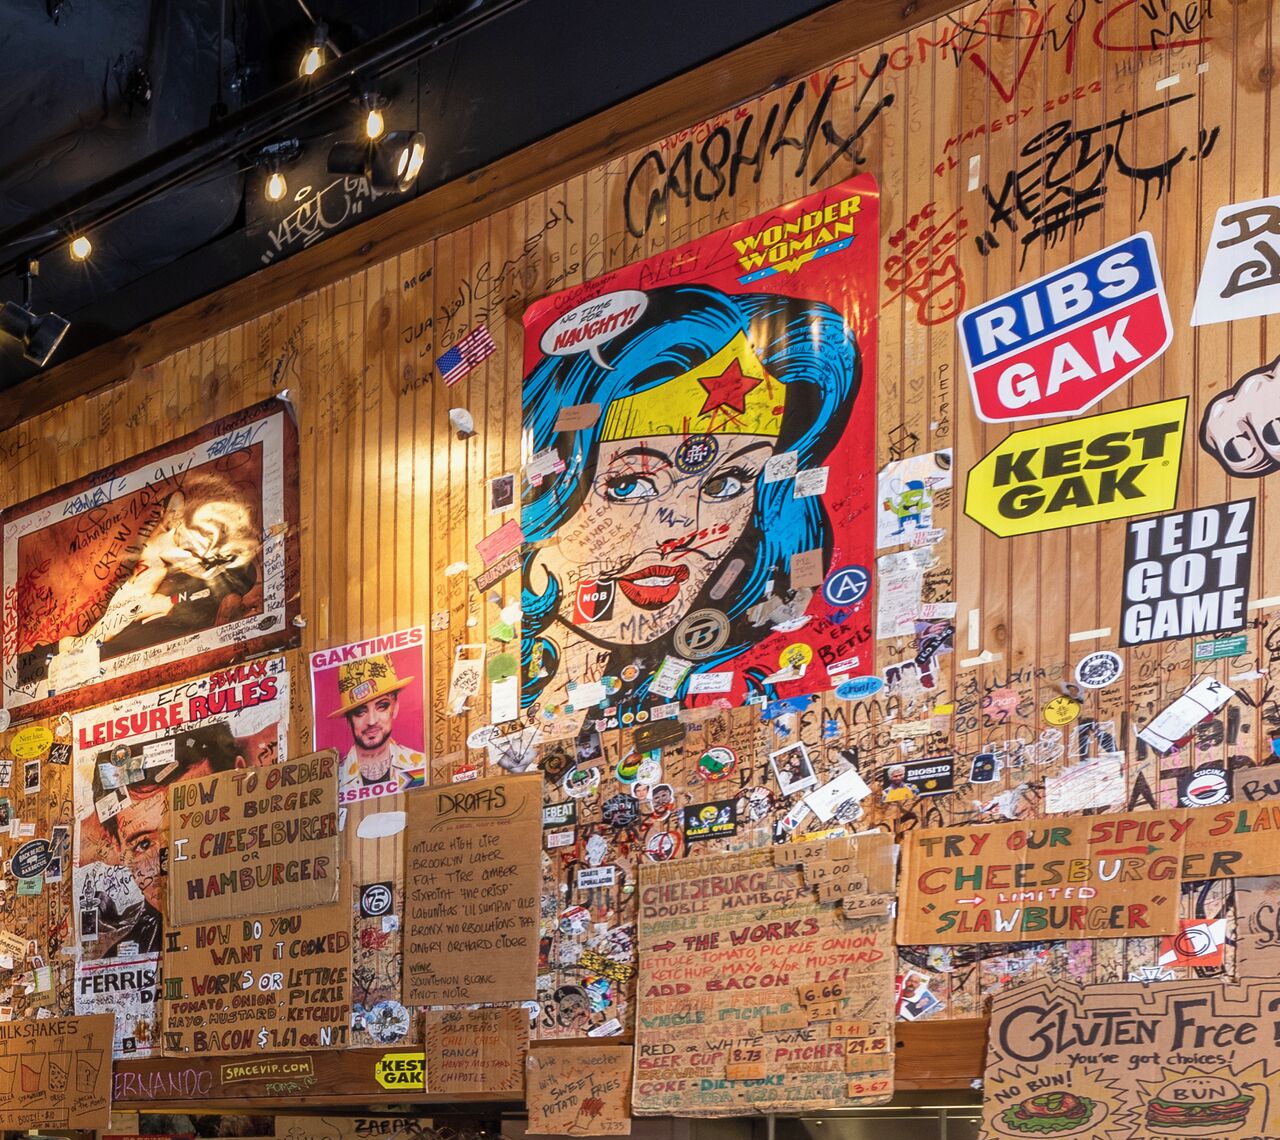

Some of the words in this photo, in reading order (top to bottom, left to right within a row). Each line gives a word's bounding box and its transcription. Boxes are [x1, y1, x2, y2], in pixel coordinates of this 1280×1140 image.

[732, 195, 861, 255] WONDER
[737, 217, 855, 272] WOMAN
[560, 312, 578, 325] NO
[581, 299, 612, 315] TIME
[975, 250, 1139, 356] RIBS
[552, 303, 640, 352] NAUGHTY!
[579, 309, 603, 325] FOR
[996, 315, 1143, 410] GAK
[993, 420, 1180, 487] KEST
[998, 463, 1150, 519] GAK
[1130, 501, 1251, 560] TEDZ
[1126, 545, 1248, 602] GOT
[583, 592, 608, 602] NOB
[1123, 587, 1245, 645] GAME
[312, 628, 423, 668] GAKTIMES
[158, 684, 198, 707] EFC
[79, 702, 184, 751] LEISURE
[189, 676, 277, 721] RULES
[174, 781, 216, 811] HOW
[233, 770, 258, 795] TO
[266, 757, 333, 787] ORDER
[1193, 769, 1226, 778] CUCINA
[180, 805, 230, 829] YOUR
[244, 788, 323, 817] BURGER
[199, 813, 338, 858] CHEESEBURGER
[920, 834, 990, 858] TRY
[1007, 827, 1072, 850] OUR
[1088, 817, 1194, 845] SPICY
[242, 851, 259, 862] OR
[784, 848, 822, 861] 11.25
[188, 857, 330, 900] HAMBURGER
[812, 863, 850, 879] 12.00
[917, 851, 1243, 895] CHEESBURGER
[643, 902, 709, 919] DOUBLE
[826, 881, 863, 897] 19.00
[997, 887, 1097, 902] LIMITED
[196, 926, 230, 949] HOW
[243, 920, 262, 940] DO
[269, 915, 302, 937] YOU
[683, 932, 720, 951] THE
[730, 918, 820, 946] WORKS
[821, 934, 877, 951] ONION
[211, 944, 263, 966] WANT
[289, 932, 350, 957] COOKED
[807, 949, 884, 967] MUSTARD
[81, 970, 155, 995] FERRIS
[192, 970, 253, 996] WORKS
[259, 972, 284, 989] OR
[287, 968, 348, 988] LETTUCE
[646, 982, 691, 997] ADD
[706, 974, 790, 992] BACON
[805, 984, 842, 1001] 6.66
[289, 988, 344, 1006] PICKLE
[287, 1006, 350, 1023] KETCHUP
[1170, 998, 1257, 1052] Free
[193, 1030, 252, 1052] BACON
[320, 1025, 348, 1046] NOT
[641, 1043, 675, 1057] RED
[706, 1036, 764, 1050] WHITE
[442, 1049, 479, 1058] RANCH
[640, 1055, 682, 1069] BEER
[690, 1052, 724, 1066] CUP
[733, 1049, 762, 1062] 8.73
[1129, 1052, 1160, 1069] got
[1167, 1050, 1236, 1066] choices!
[226, 1062, 309, 1079] SPACEVIP.COM
[384, 1072, 422, 1082] GAK
[440, 1072, 487, 1082] CHIPOTLE
[542, 1095, 578, 1117] POTATO
[590, 1080, 621, 1099] FRIES
[550, 1073, 596, 1100] SWEET
[640, 1081, 686, 1093] COKE
[854, 1081, 889, 1094] 3.67
[995, 1083, 1020, 1103] NO
[1028, 1071, 1073, 1092] BUN!
[1174, 1084, 1226, 1100] BUN
